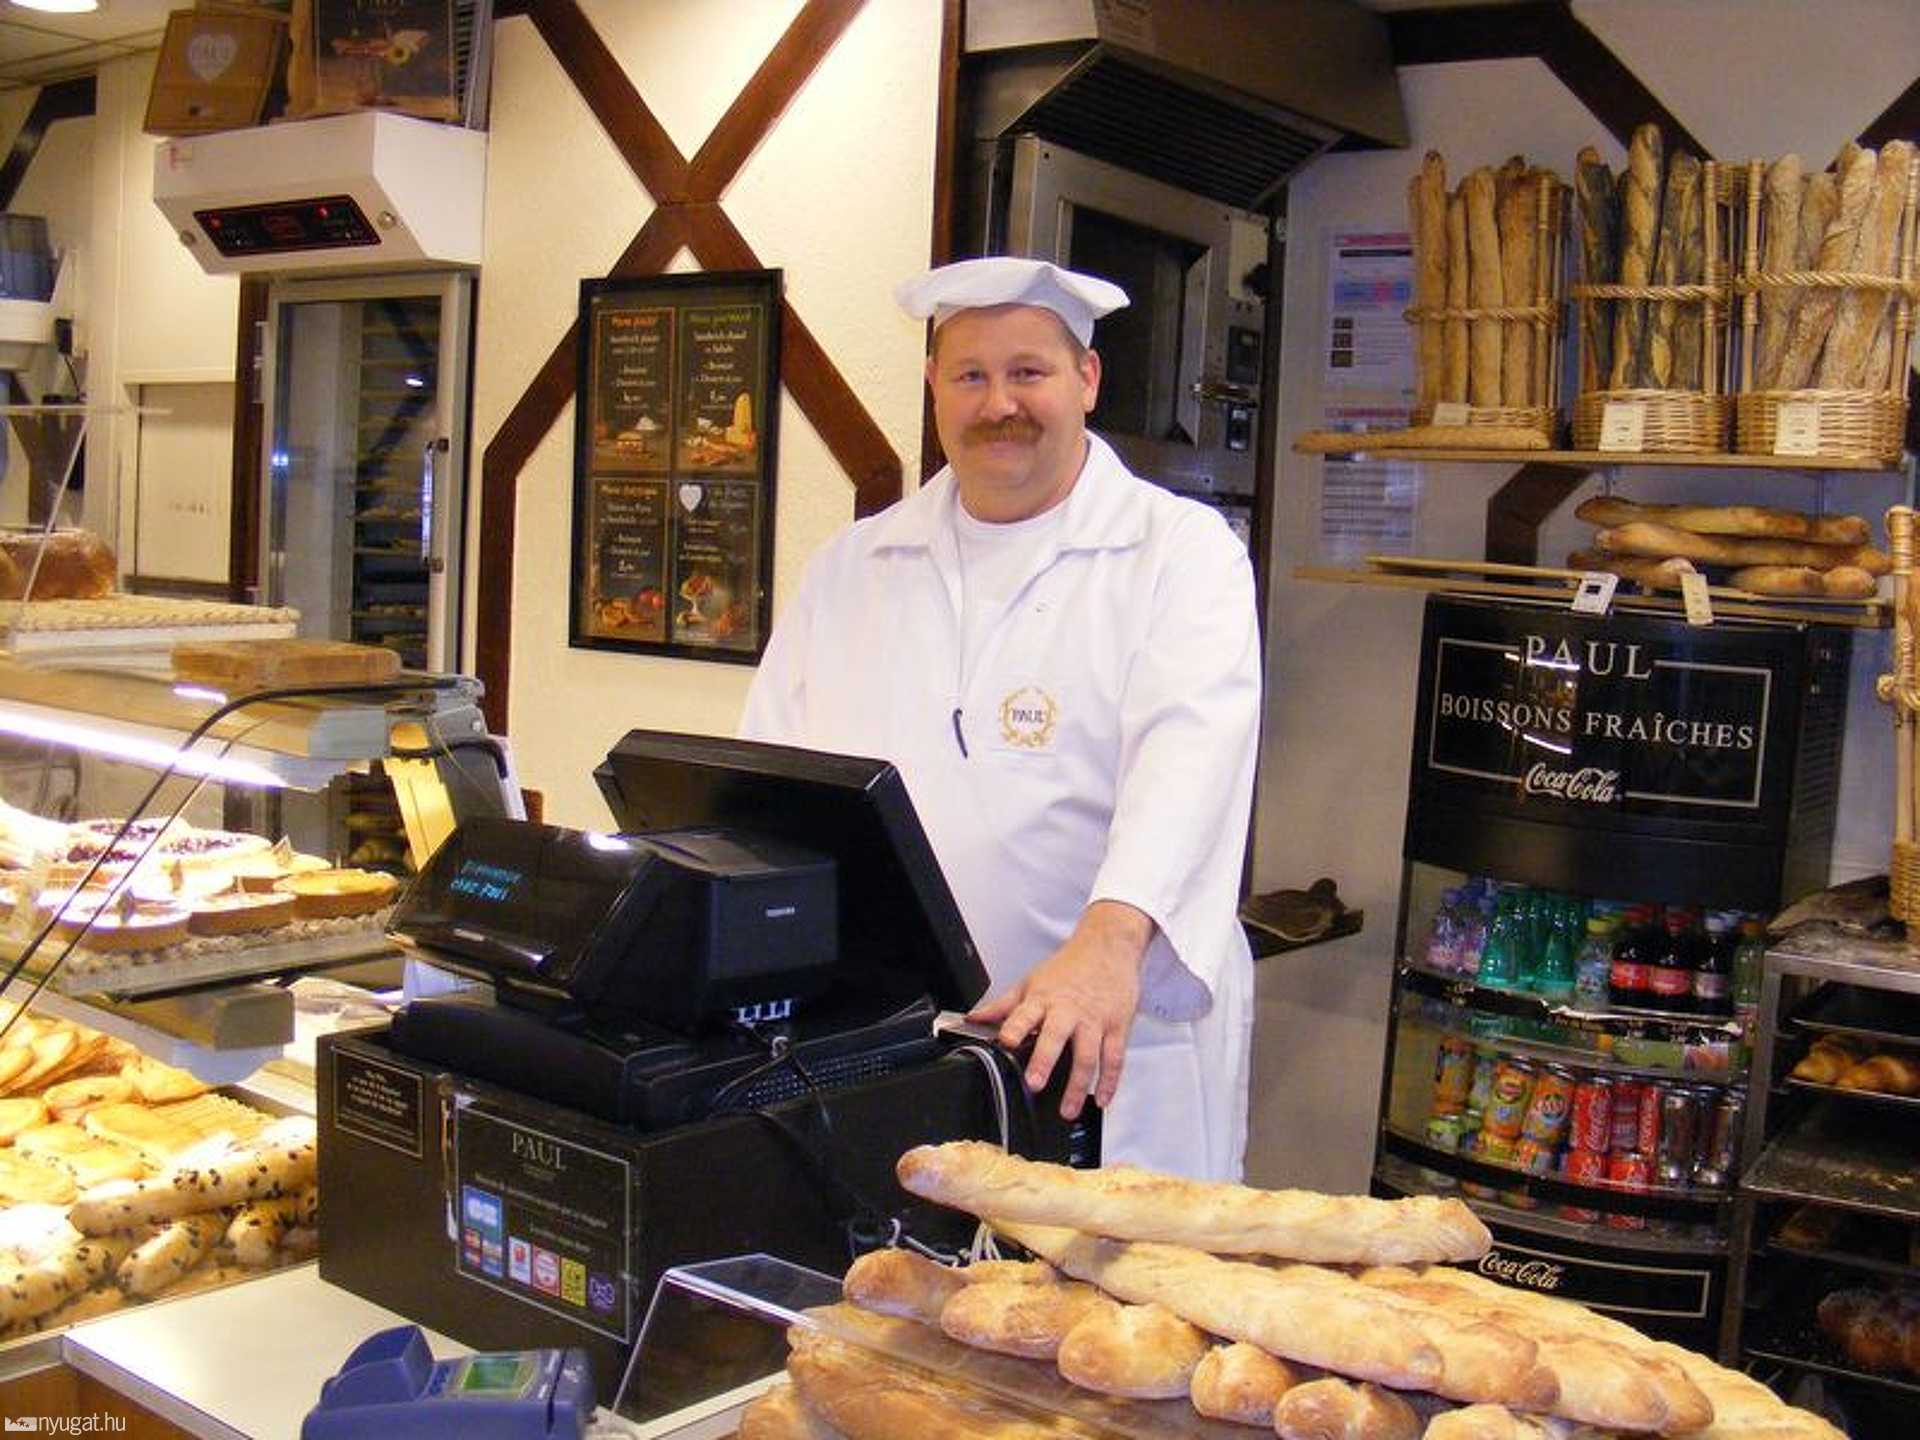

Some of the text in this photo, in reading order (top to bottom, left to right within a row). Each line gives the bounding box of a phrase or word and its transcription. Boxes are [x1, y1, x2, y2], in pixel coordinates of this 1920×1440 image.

[1524, 635, 1652, 681] PAUL
[1012, 708, 1044, 723] PAUL
[1441, 693, 1755, 751] BOISSONS FRAÎCHES
[1524, 762, 1620, 803] Coca-Cola
[511, 1131, 566, 1172] PAUL
[1477, 1251, 1566, 1290] Coca-Cola
